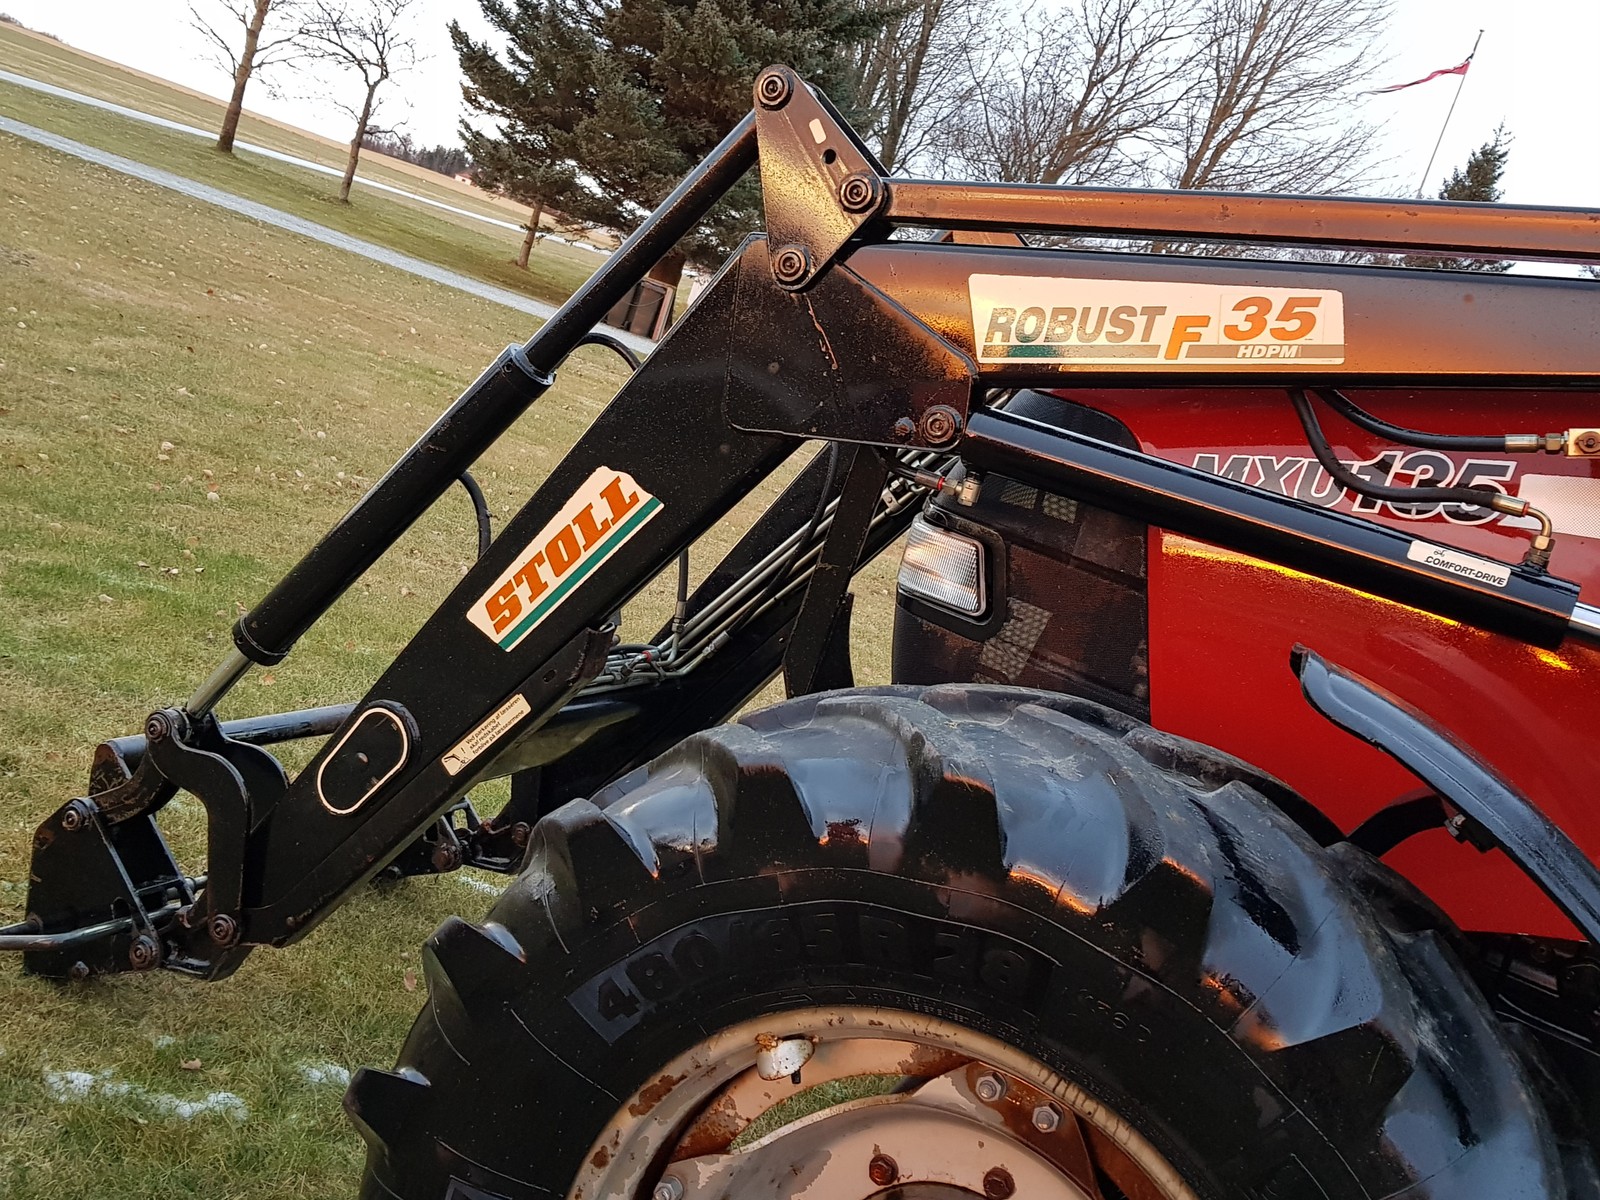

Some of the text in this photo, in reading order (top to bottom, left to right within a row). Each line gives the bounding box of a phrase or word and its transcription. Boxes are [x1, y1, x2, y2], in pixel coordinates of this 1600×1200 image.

[985, 296, 1322, 360] ROBUST F 35
[1237, 344, 1299, 358] HDPM
[485, 475, 640, 635] STOLL
[1425, 555, 1506, 587] COMFORT-DRIVE
[475, 718, 496, 738] parkering
